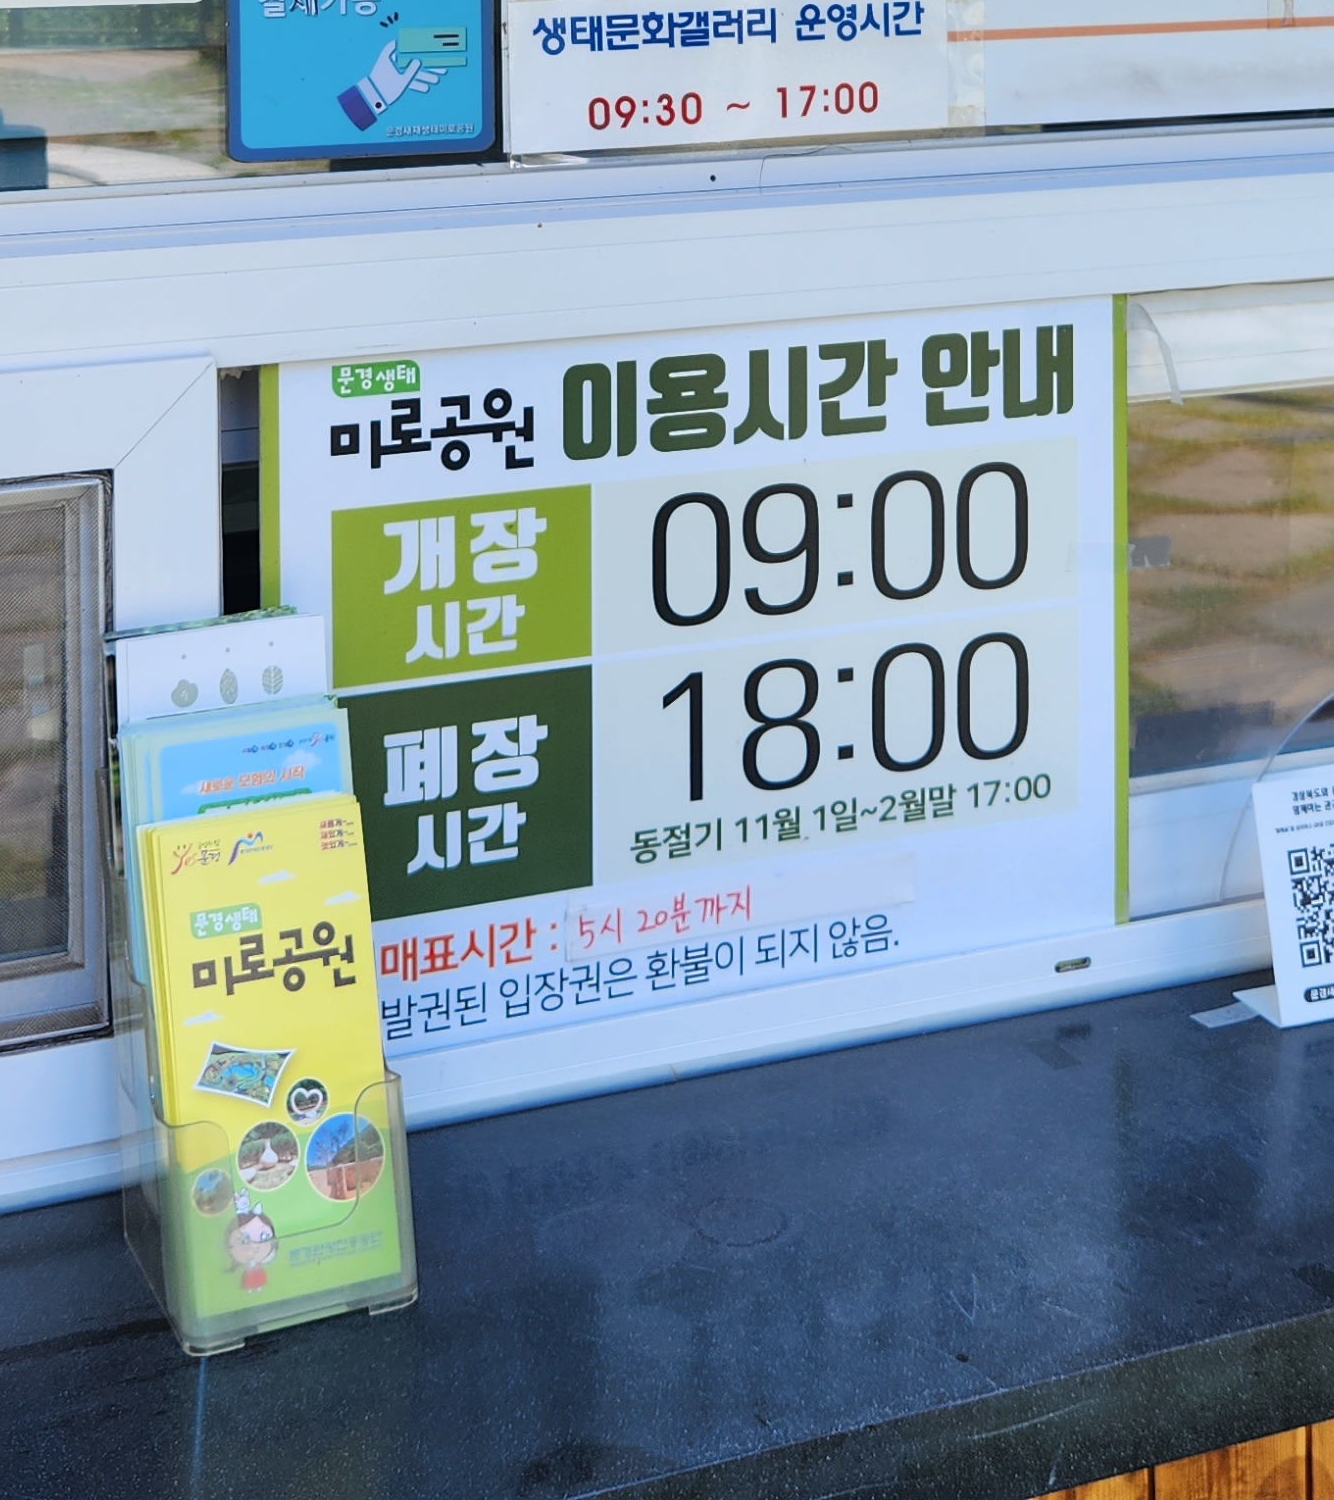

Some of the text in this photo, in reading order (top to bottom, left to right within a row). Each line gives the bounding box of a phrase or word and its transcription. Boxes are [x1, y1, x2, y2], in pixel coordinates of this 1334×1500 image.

[532, 0, 925, 56] 생태문화갤러리 운영시간
[588, 81, 880, 131] 09:30 17:00
[330, 323, 1075, 471] 미로공원 이용시간 안내
[336, 364, 417, 393] 문경생태
[405, 461, 1029, 665] 시간 09:00
[661, 632, 1030, 802] 18:00
[406, 802, 528, 878] 시간
[630, 773, 1052, 865] 동절기 11월 1일~2월말 17:00
[194, 905, 259, 932] 문경생태
[380, 918, 537, 984] 매표시간
[578, 906, 624, 949] 5시
[192, 921, 357, 996] 미로공원
[380, 914, 901, 1041] 발권된 입장권은 환불이 되지 않음.
